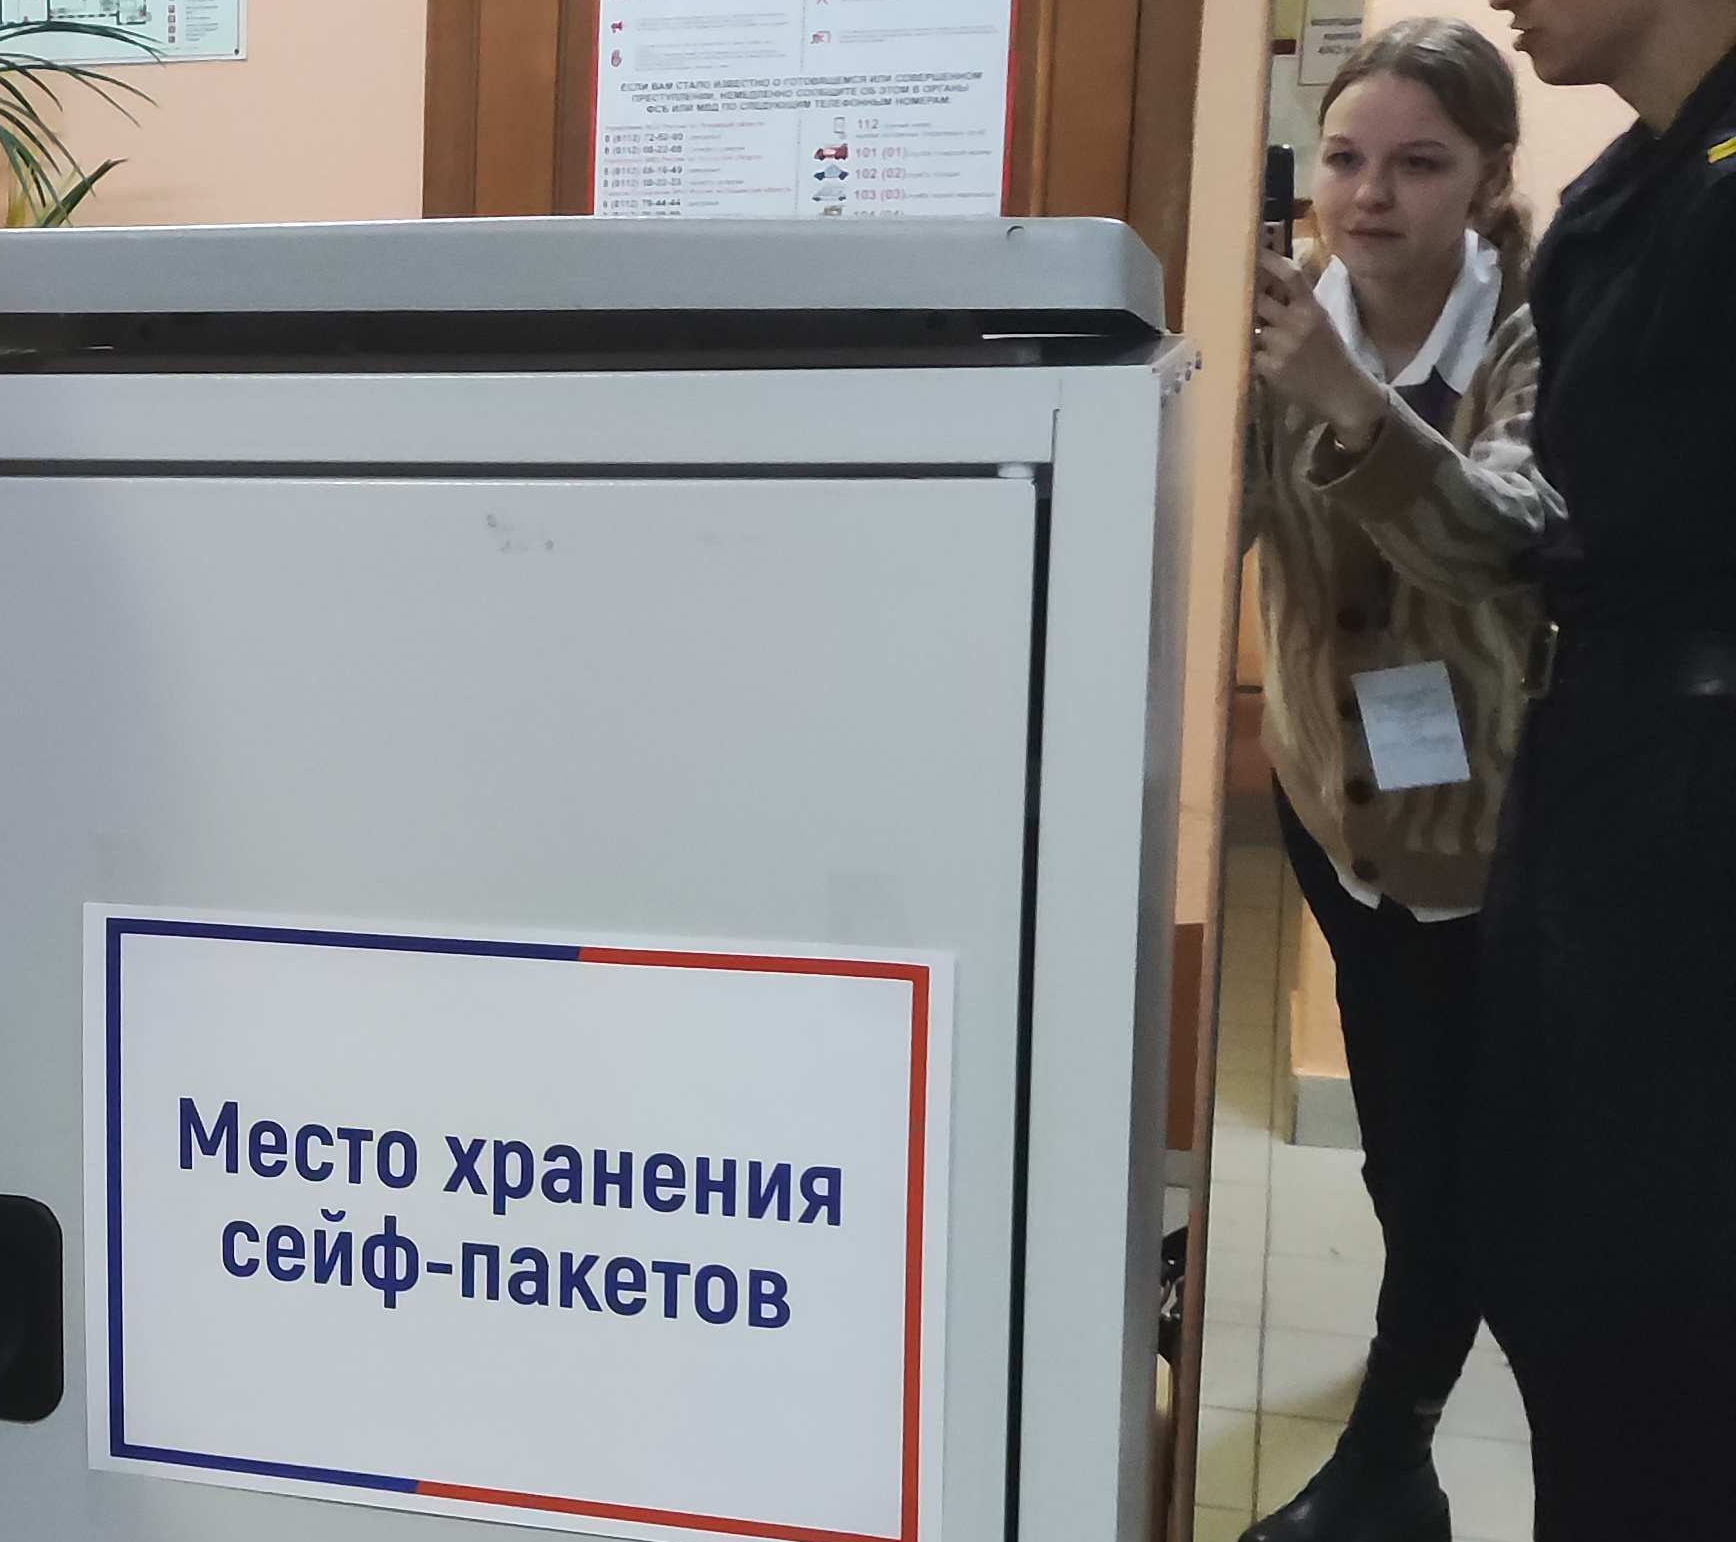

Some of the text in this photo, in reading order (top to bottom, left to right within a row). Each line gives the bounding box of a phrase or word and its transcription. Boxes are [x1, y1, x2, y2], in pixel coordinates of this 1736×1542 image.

[857, 118, 879, 130] 112
[855, 147, 877, 159] 101
[855, 168, 878, 180] 102
[854, 189, 877, 201] 103
[178, 1097, 844, 1228] Место хранения
[220, 1207, 792, 1330] сейф-пакетов
